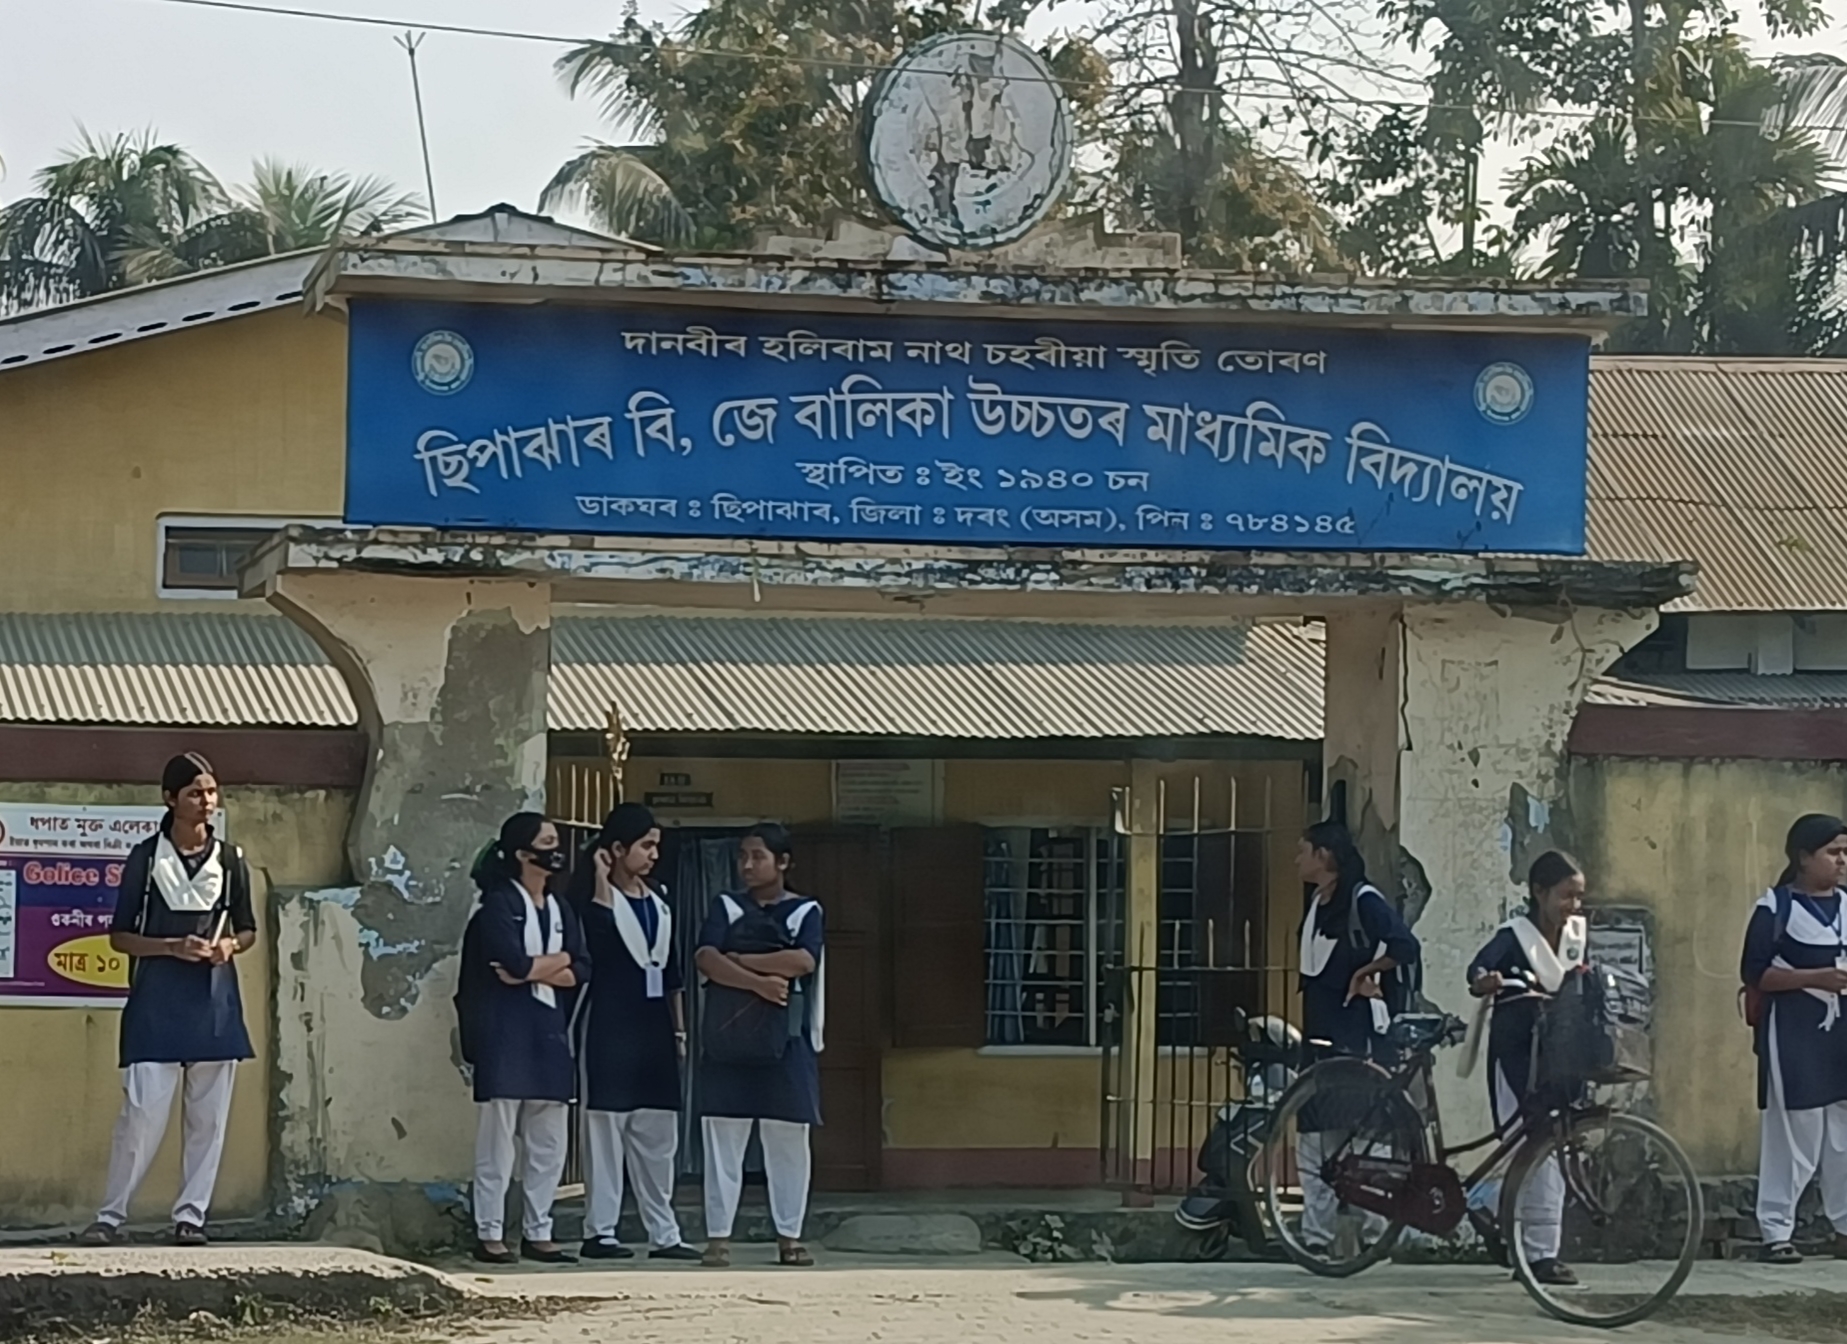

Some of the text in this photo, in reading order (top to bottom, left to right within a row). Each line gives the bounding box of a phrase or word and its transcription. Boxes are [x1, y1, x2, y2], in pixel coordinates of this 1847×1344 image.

[903, 340, 973, 365] নাথ
[1116, 340, 1201, 377] স্মৃতি
[1217, 349, 1327, 375] তোৰণ
[413, 414, 614, 498] ছিপাঝাৰ
[712, 397, 779, 447] জে
[788, 373, 955, 441] বালিকা
[965, 374, 1131, 447] উচ্চতৰ
[1142, 400, 1333, 475] মাধ্যমিক
[1344, 421, 1525, 525] বিদ্যালয়
[794, 456, 905, 490] স্থাপিত
[934, 459, 983, 491] ইং
[997, 468, 1094, 490] ১৯৪০
[1103, 470, 1150, 492] চন
[574, 495, 678, 518] ডাকঘৰ
[848, 496, 923, 525] জিলা
[954, 507, 1010, 529] দৰং
[1135, 504, 1190, 531] পিন
[1225, 513, 1355, 535] ৭৮৪১৪৫
